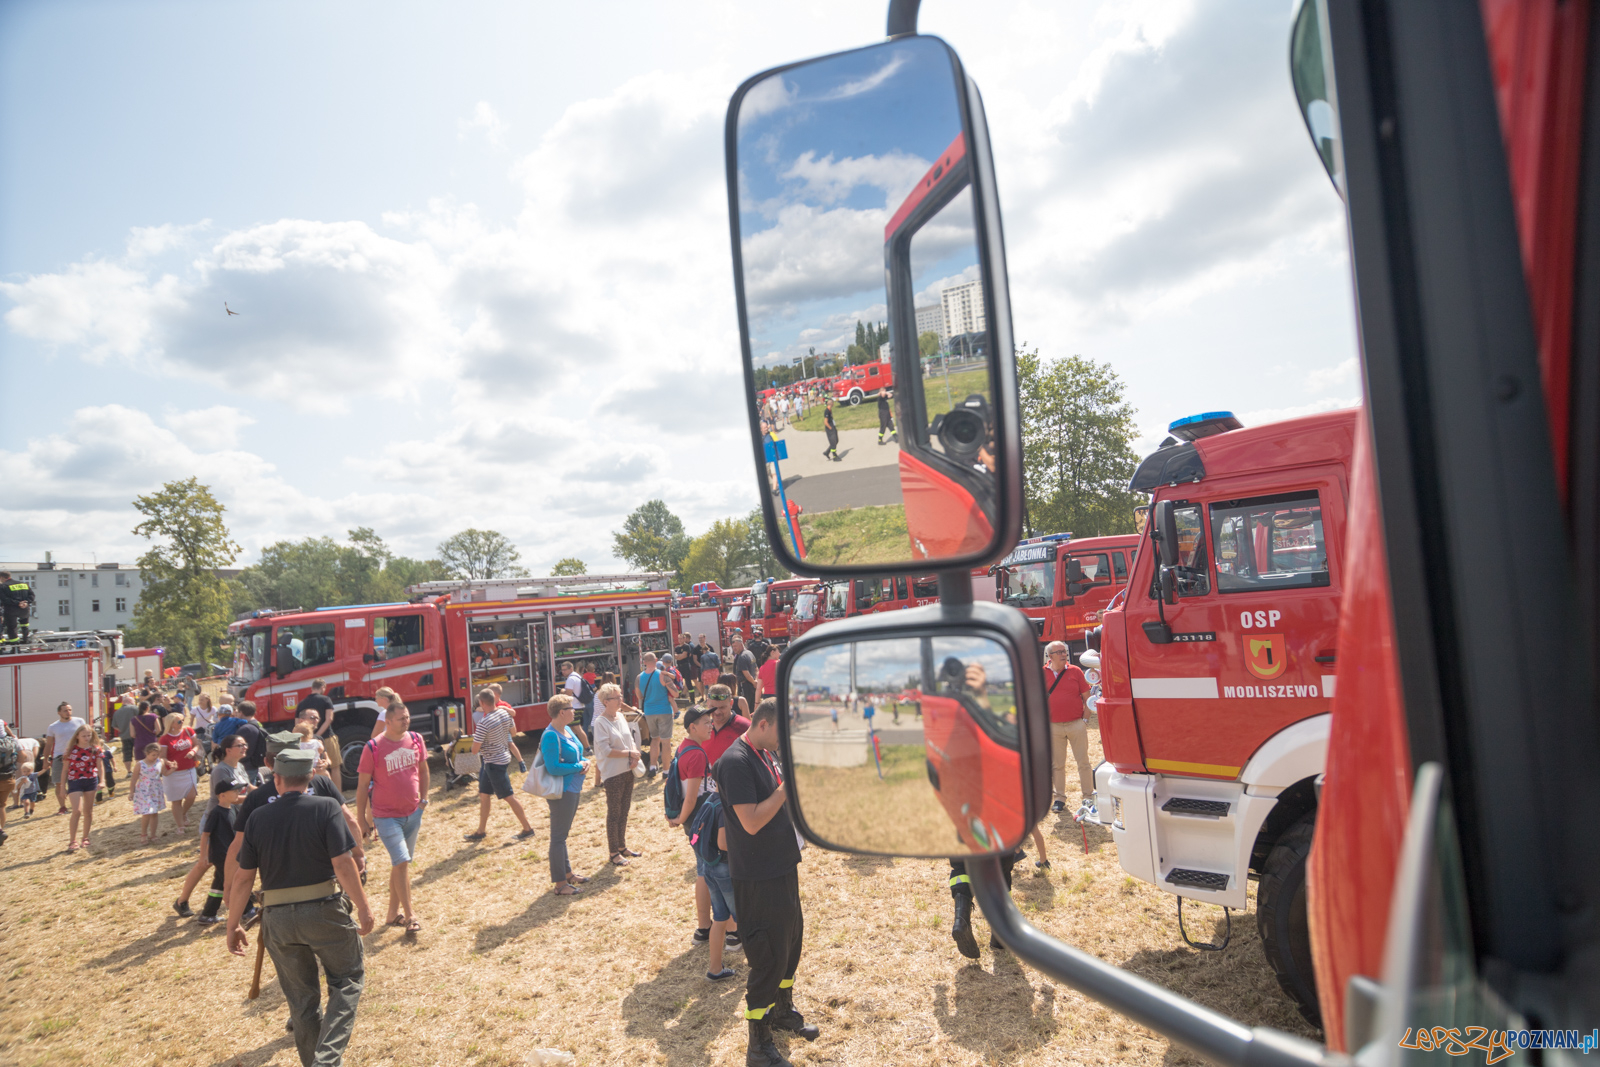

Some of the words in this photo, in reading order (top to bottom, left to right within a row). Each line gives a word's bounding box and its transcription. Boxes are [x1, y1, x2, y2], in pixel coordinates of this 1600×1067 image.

[1013, 547, 1047, 562] JABŁONNA
[1240, 610, 1281, 629] OSP
[1173, 634, 1213, 642] 43118
[1223, 685, 1318, 698] MODLISZEWO
